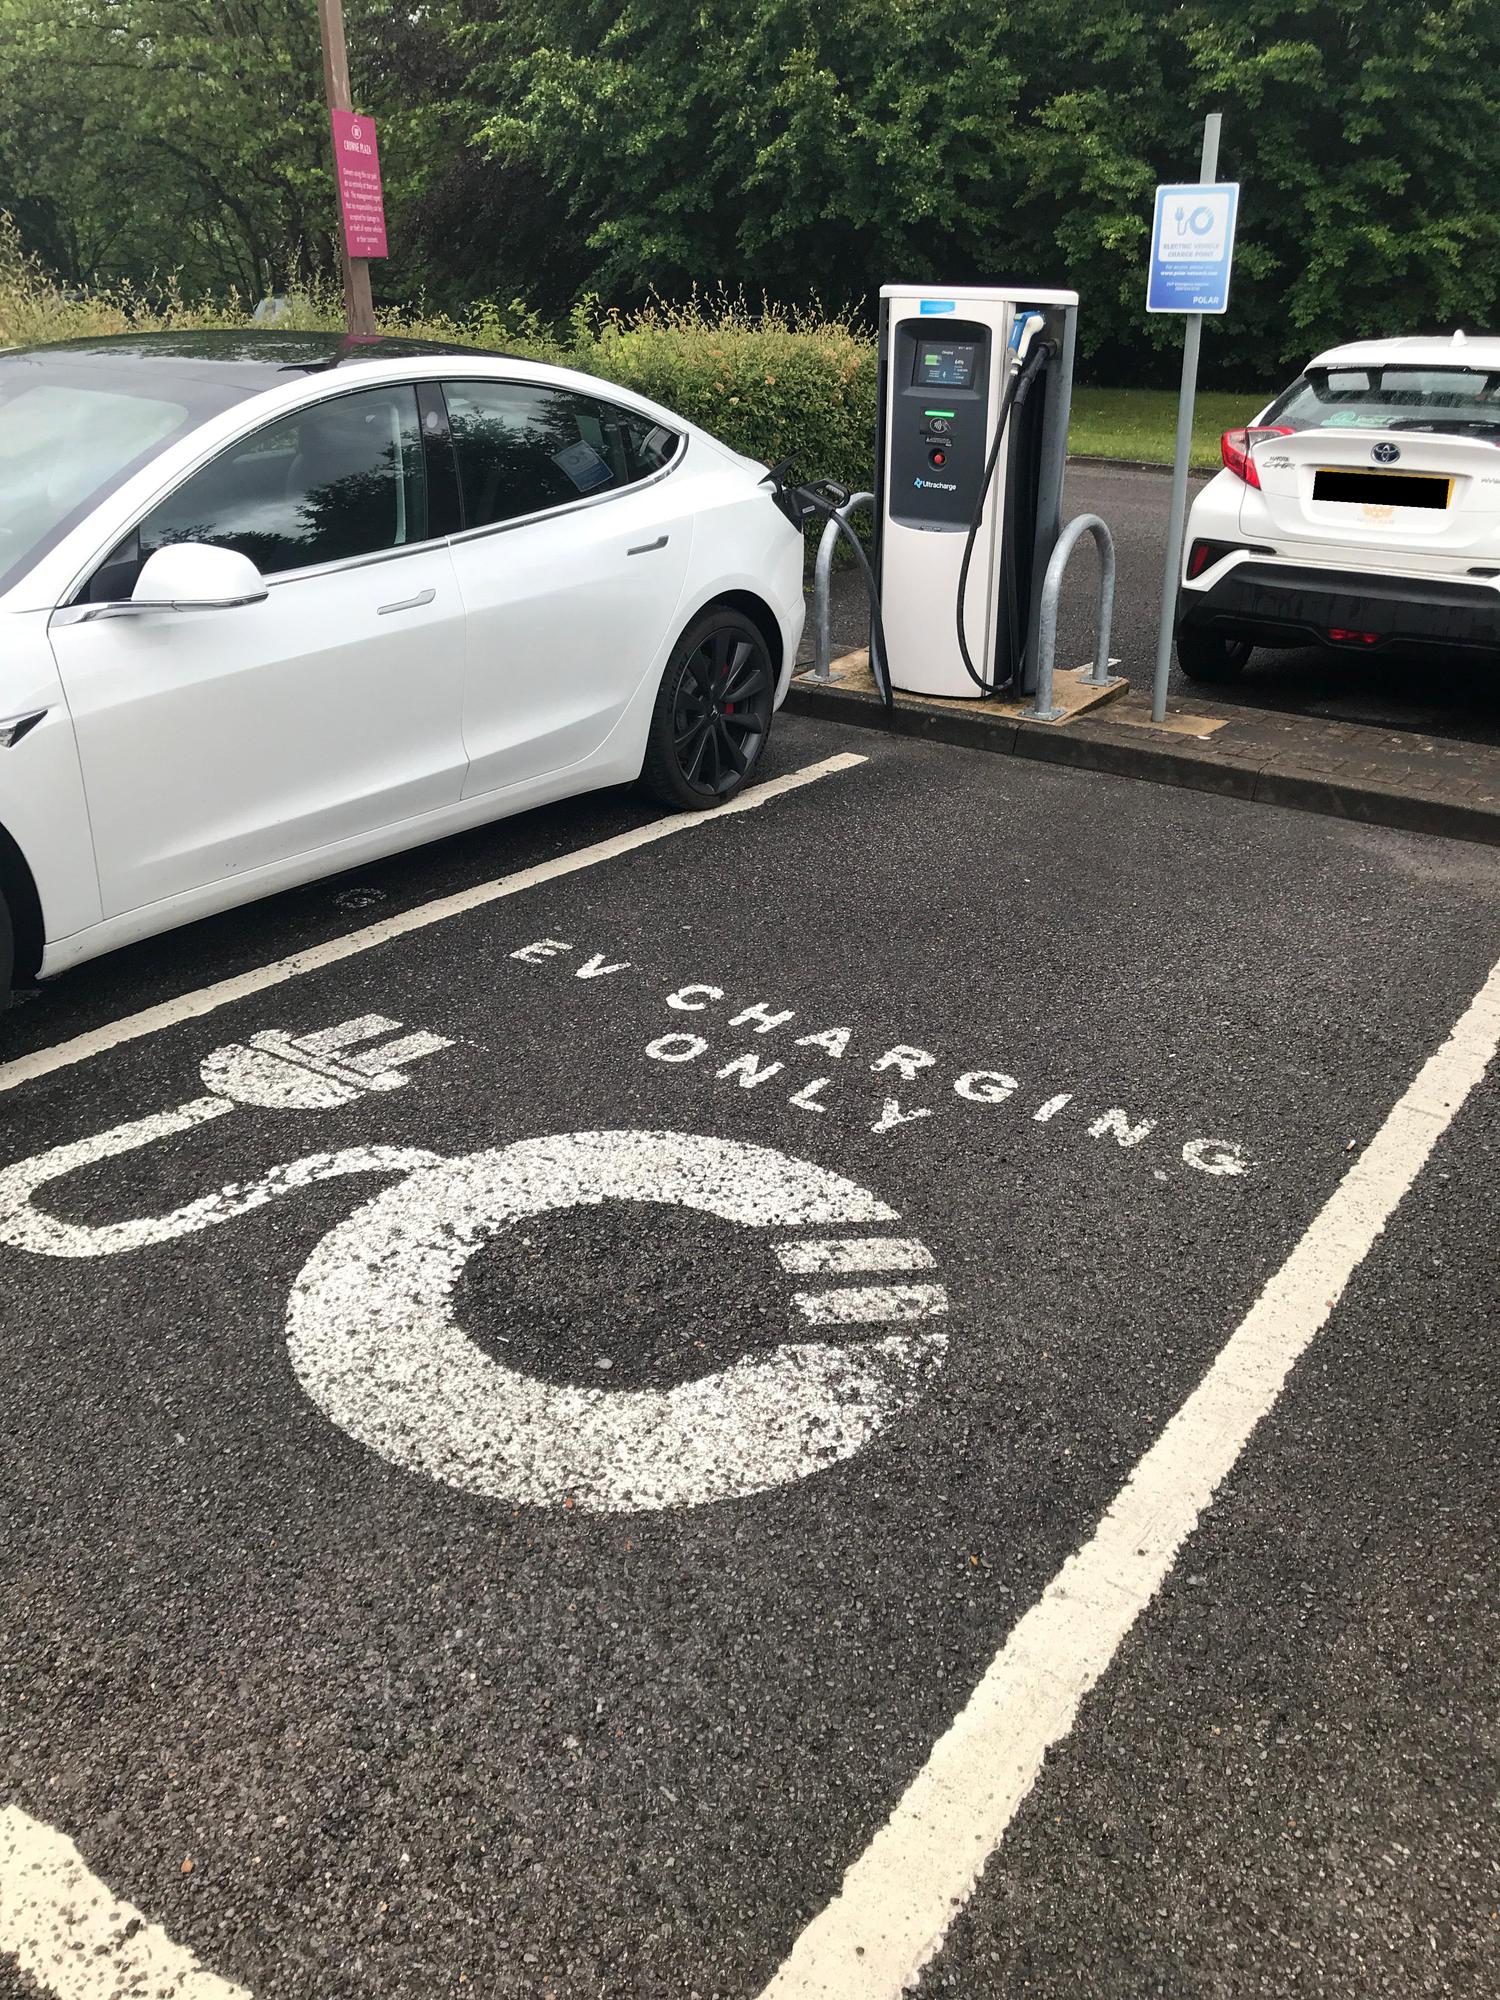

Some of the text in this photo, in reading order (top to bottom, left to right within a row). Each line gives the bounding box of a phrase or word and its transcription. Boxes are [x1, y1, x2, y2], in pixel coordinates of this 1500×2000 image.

[1192, 296, 1219, 305] POLAR
[922, 480, 957, 491] Ultracharge
[509, 938, 1251, 1176] EV CHARGING
[645, 1032, 932, 1134] ONLY
